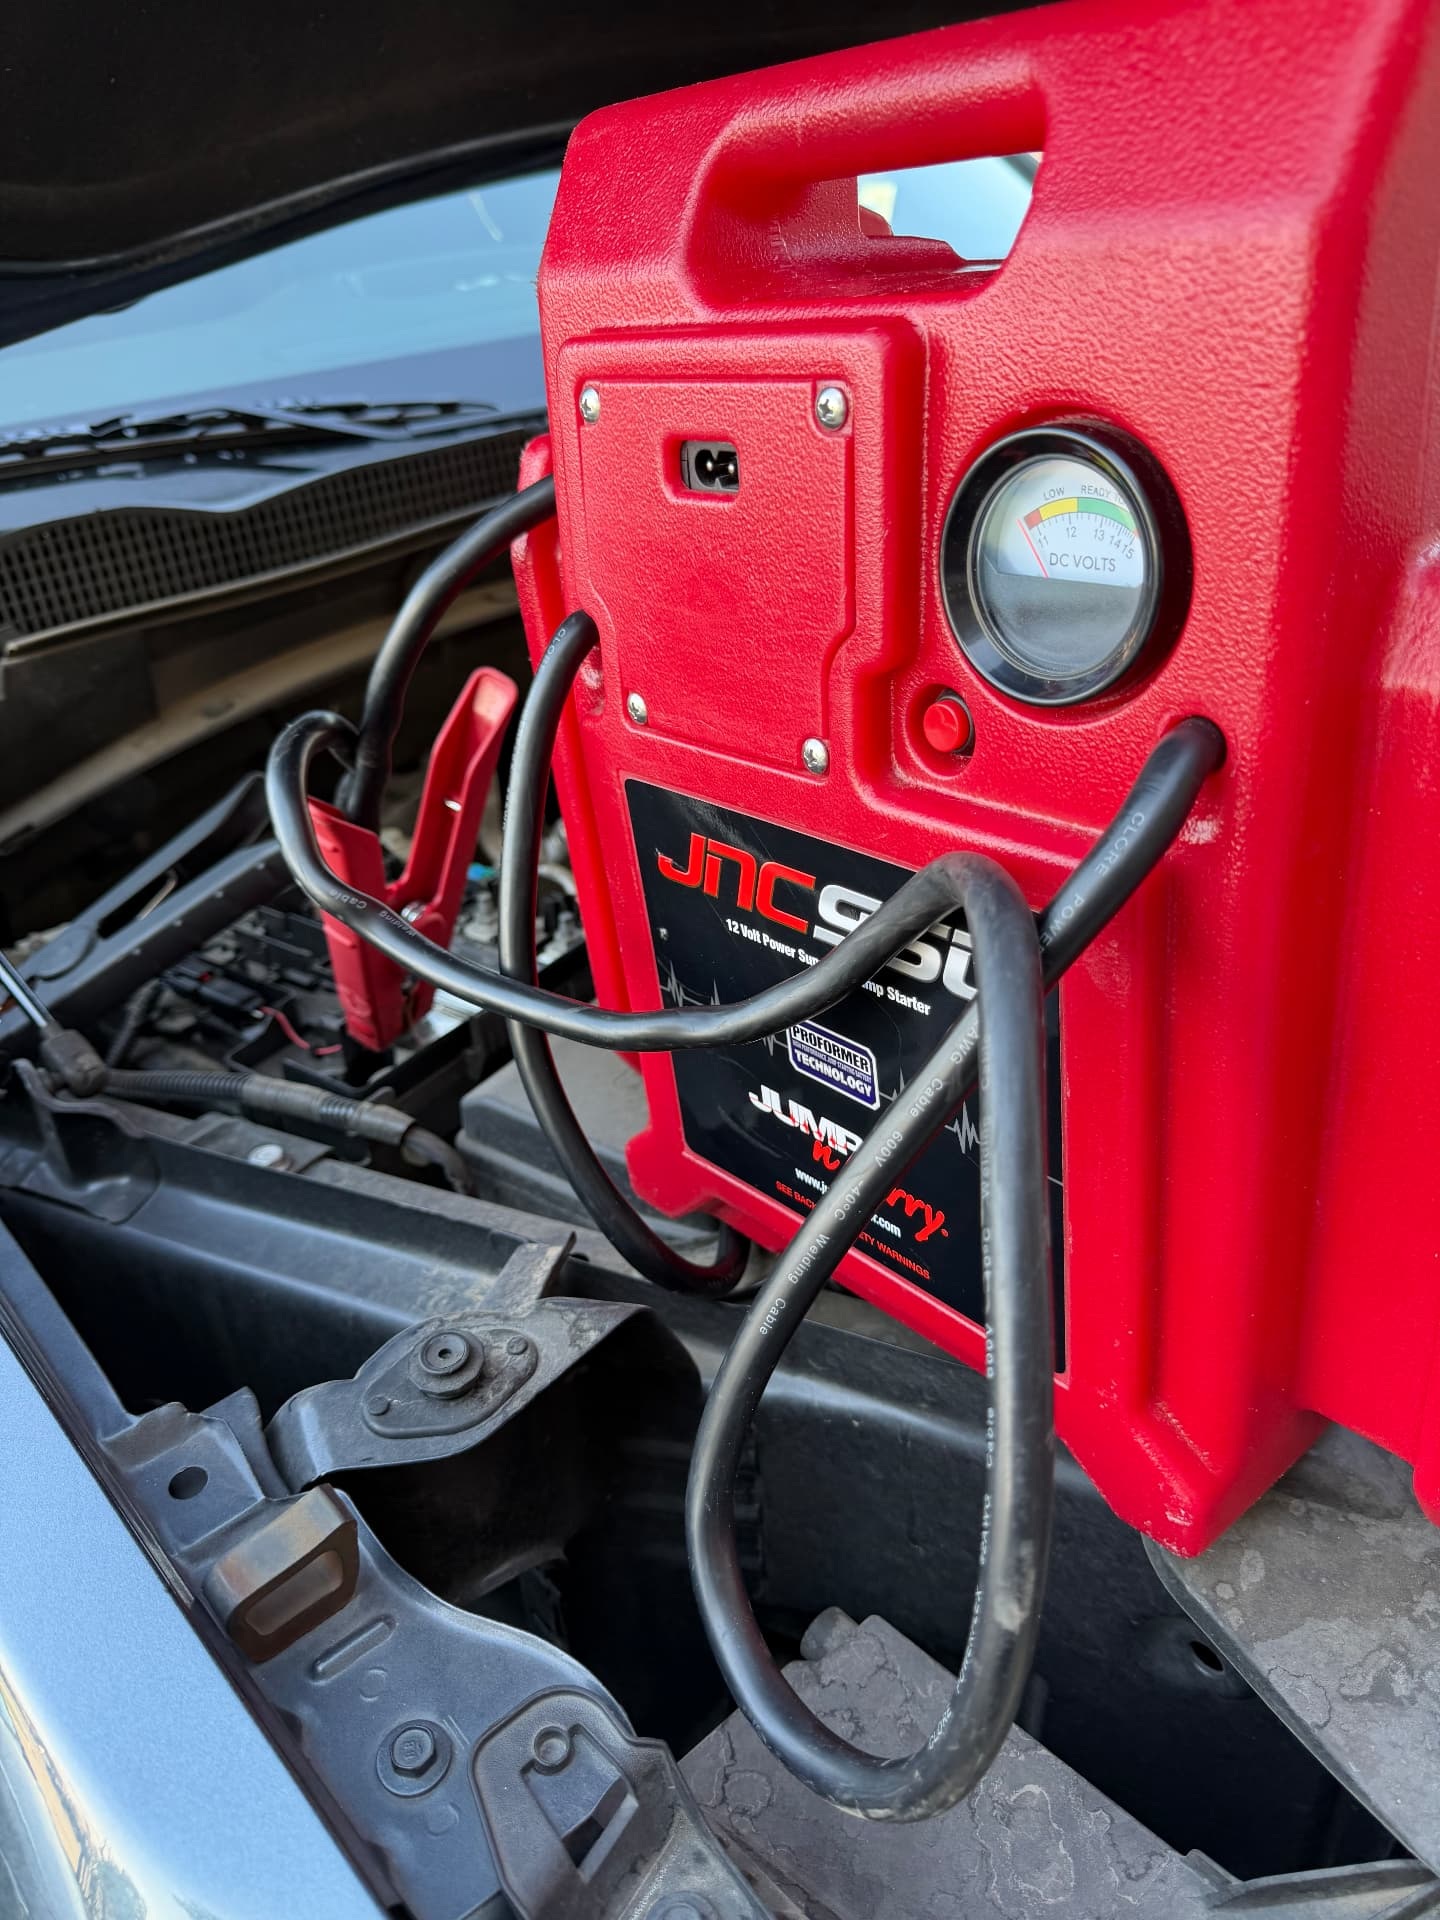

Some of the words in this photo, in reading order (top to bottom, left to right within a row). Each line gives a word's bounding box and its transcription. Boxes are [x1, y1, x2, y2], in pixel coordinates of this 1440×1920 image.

[1043, 487, 1065, 500] LOW
[1081, 484, 1110, 498] READY
[1038, 535, 1049, 549] 11
[1065, 526, 1077, 539] 12
[1094, 528, 1105, 542] 13
[1109, 535, 1121, 549] 14
[1121, 544, 1135, 560] 15
[1049, 552, 1070, 568] DC
[1073, 554, 1116, 573] VOLTS
[1094, 812, 1145, 876] CLORE
[328, 888, 368, 910] Cable
[378, 909, 417, 938] Welding
[1039, 893, 1085, 952] POWE
[726, 918, 740, 935] 12
[740, 923, 762, 944] Volt
[762, 932, 796, 959] Power
[862, 980, 884, 998] mp
[886, 986, 931, 1016] Starter
[792, 1025, 870, 1074] PROFORMER
[950, 1023, 979, 1065] AWG
[794, 1049, 872, 1097] TECHNOLOGY
[909, 1077, 944, 1118] Cable
[748, 1084, 863, 1156] JUMP
[874, 1130, 903, 1168] 600V
[775, 1180, 793, 1198] SEE
[876, 1240, 931, 1280] WARNINGS
[787, 1233, 831, 1285] Welding
[759, 1297, 786, 1335] Cable
